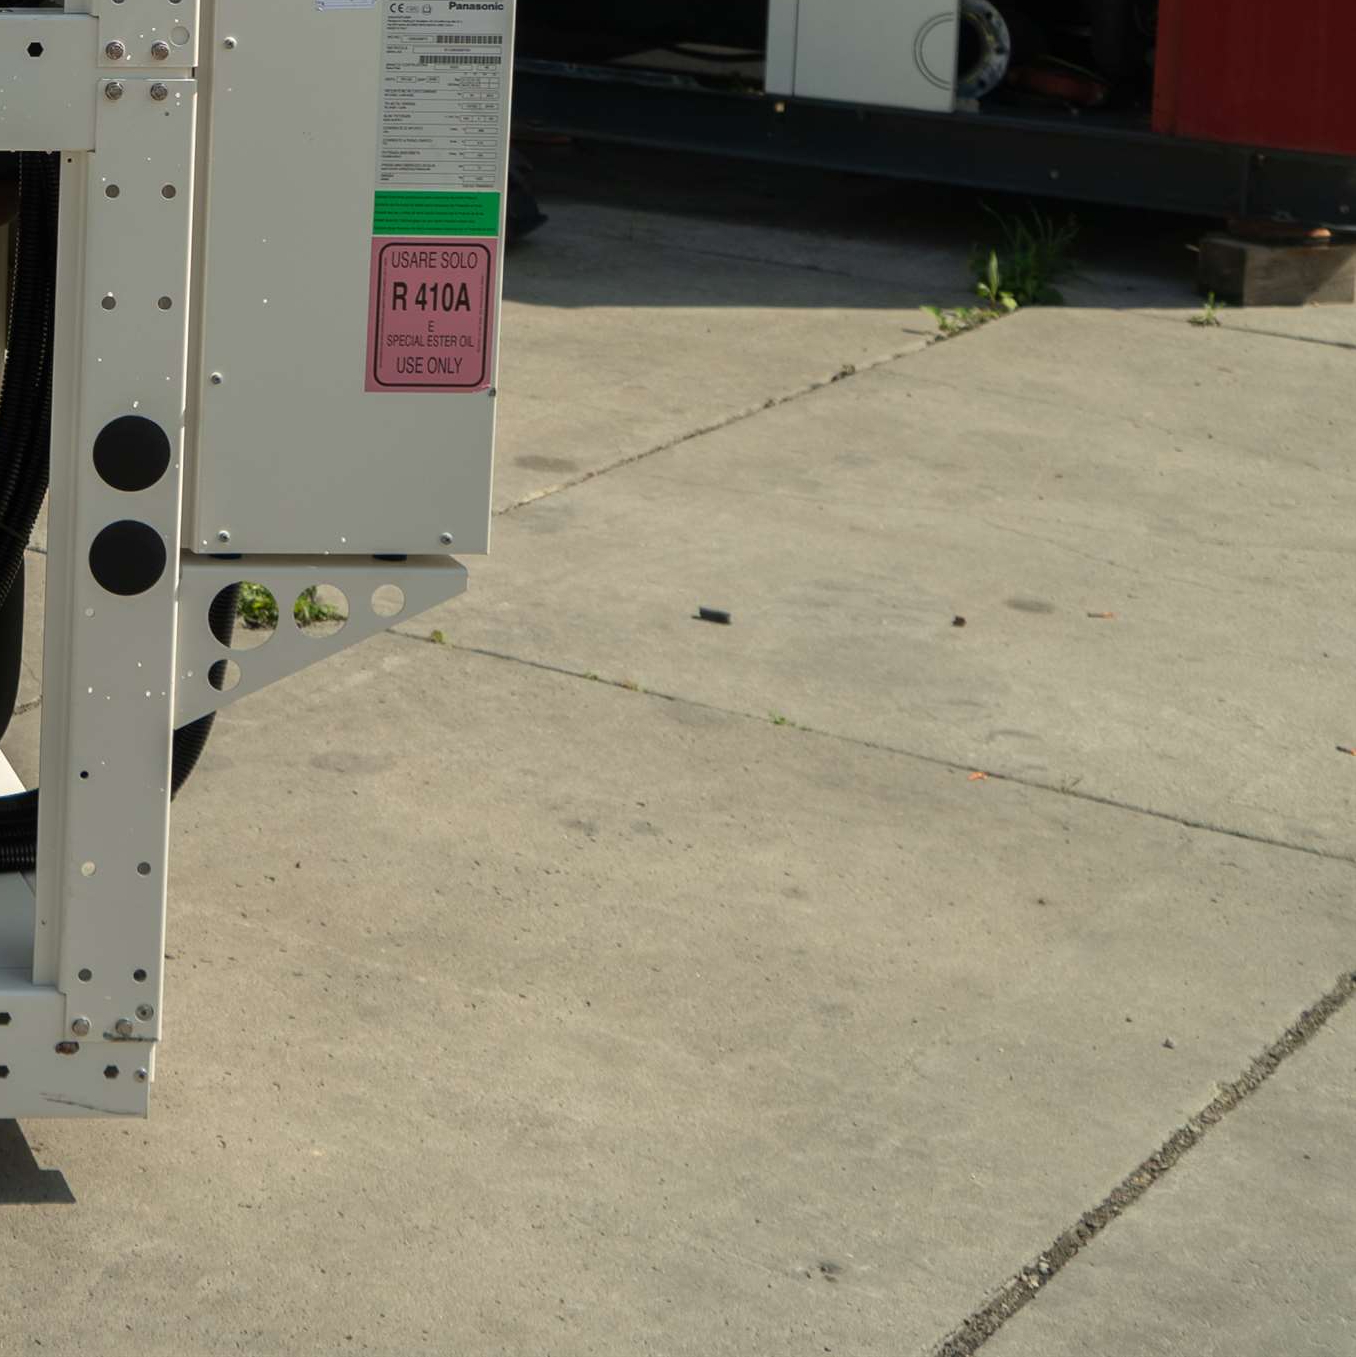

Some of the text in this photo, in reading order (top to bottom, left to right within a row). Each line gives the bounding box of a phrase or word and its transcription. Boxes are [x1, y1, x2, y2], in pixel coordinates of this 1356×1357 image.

[448, 1, 504, 11] Panasonic
[391, 251, 478, 269] USARE SOLO
[392, 282, 471, 311] R 410A
[428, 320, 435, 332] E
[386, 334, 475, 348] SPECIAL ESTER OIL
[396, 356, 464, 375] USE ONLY
